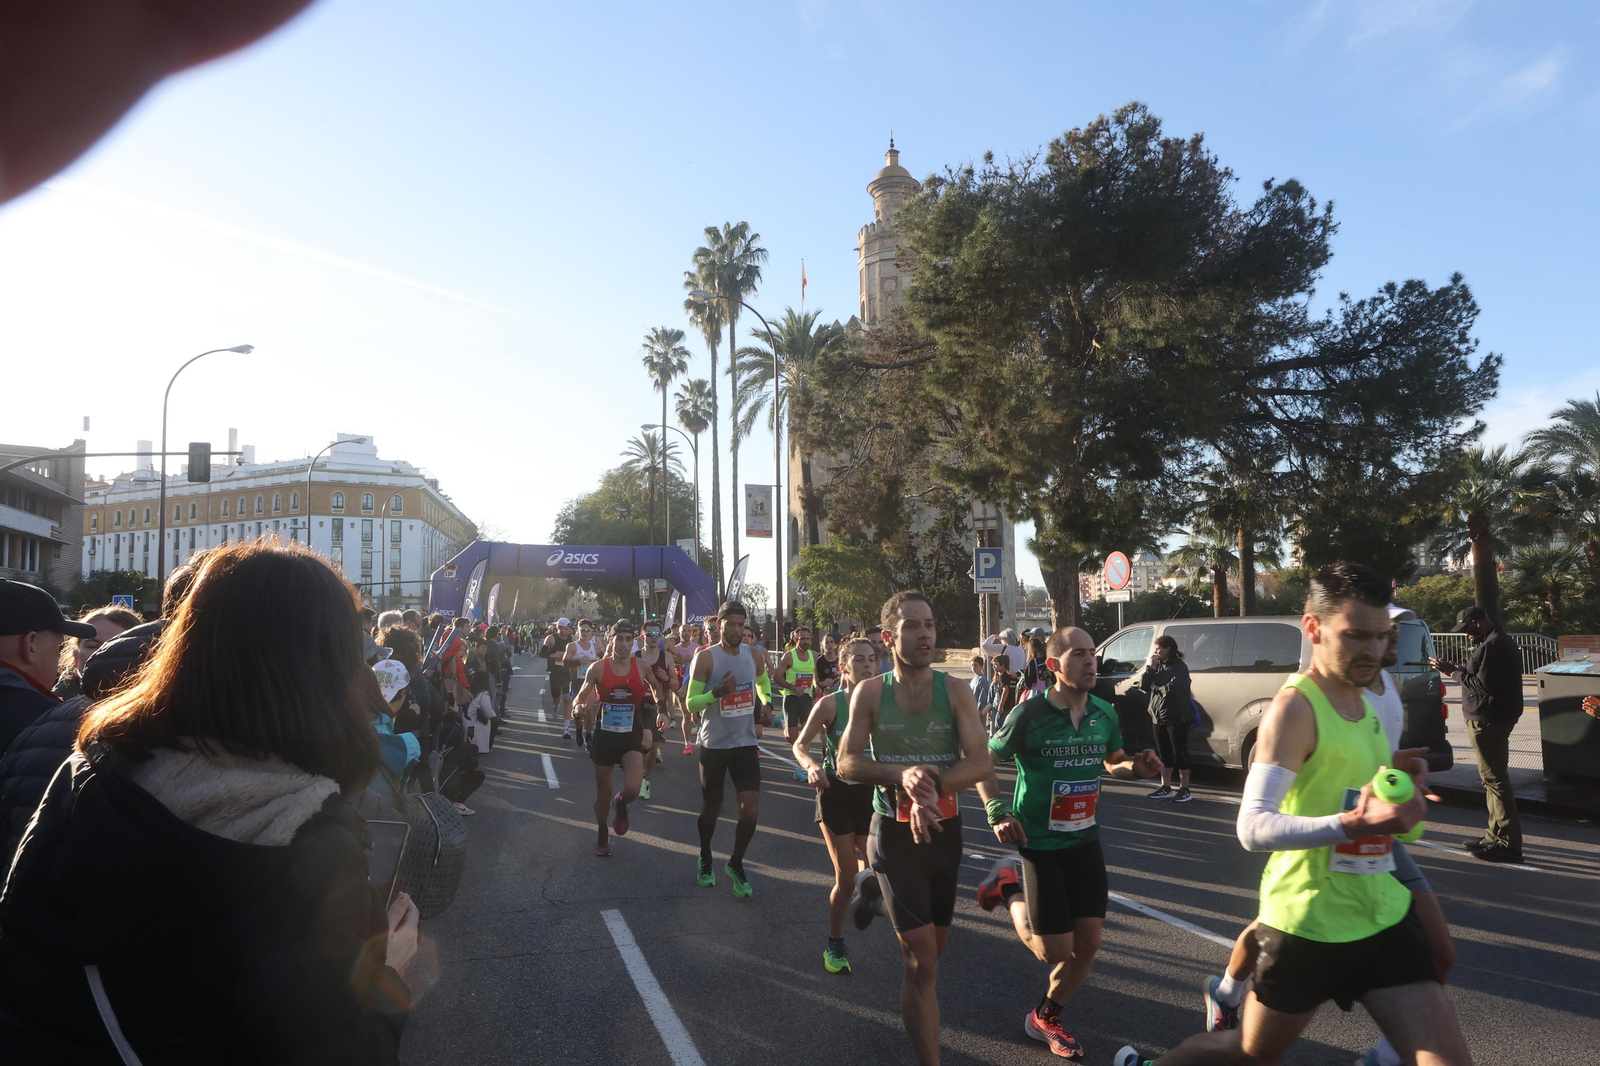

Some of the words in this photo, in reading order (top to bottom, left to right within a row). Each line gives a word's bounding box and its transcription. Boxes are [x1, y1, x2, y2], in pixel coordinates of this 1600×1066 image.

[979, 552, 996, 577] P
[1041, 745, 1080, 757] GOIERRI
[1053, 757, 1102, 768] EKUON
[1074, 802, 1086, 810] 979
